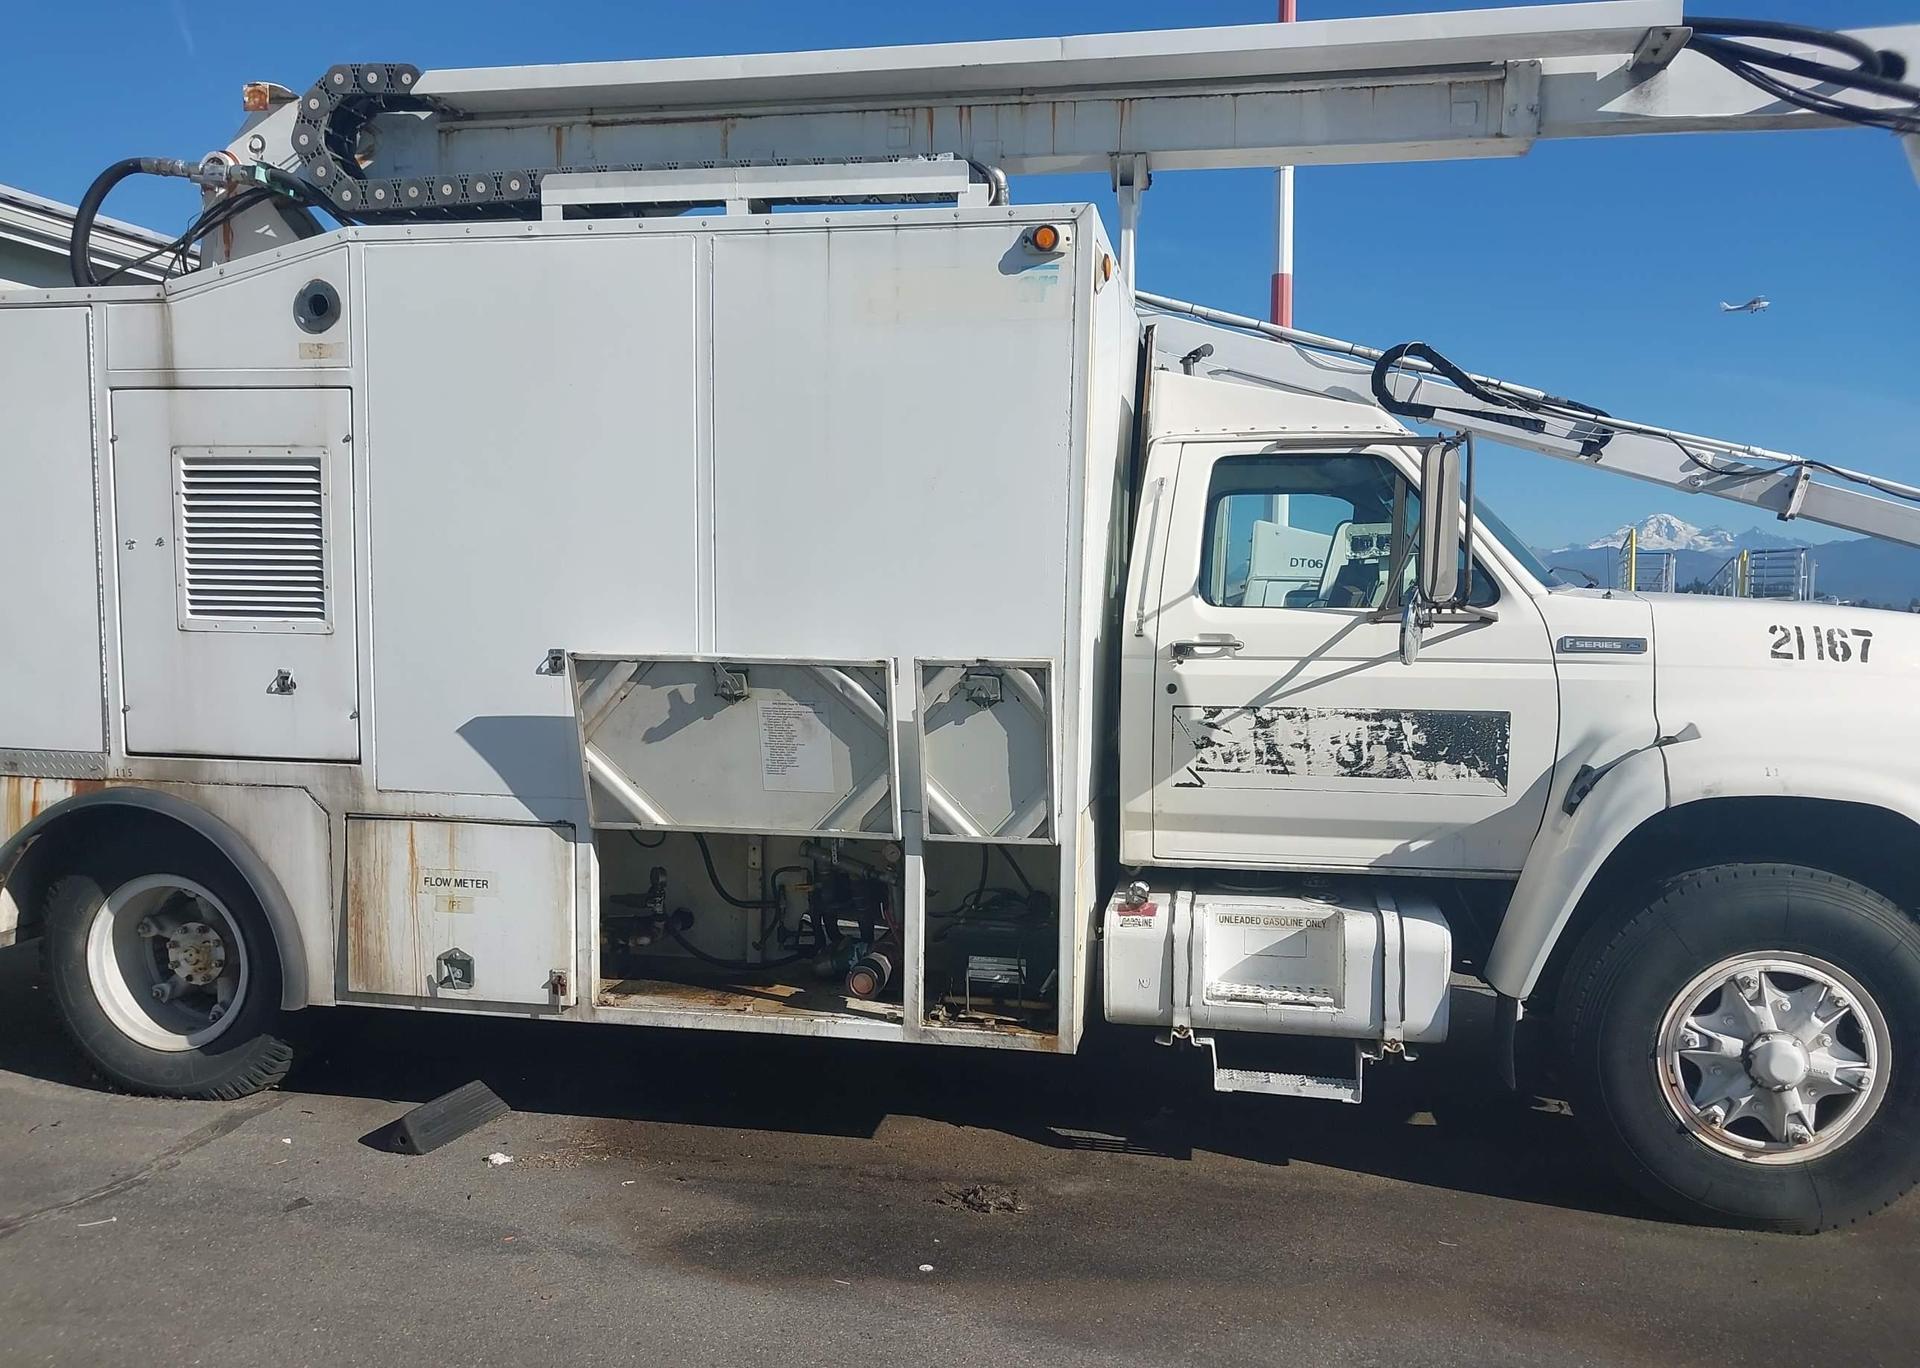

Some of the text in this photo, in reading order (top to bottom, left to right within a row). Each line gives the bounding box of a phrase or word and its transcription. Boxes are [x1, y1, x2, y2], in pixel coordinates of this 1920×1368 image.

[1290, 557, 1324, 569] DT06
[1565, 638, 1575, 649] F
[1576, 640, 1622, 649] SERIES
[1768, 624, 1873, 663] 21167
[424, 876, 489, 889] FLOW METER
[1218, 915, 1327, 929] UNLEADED GASOLINE ONLY
